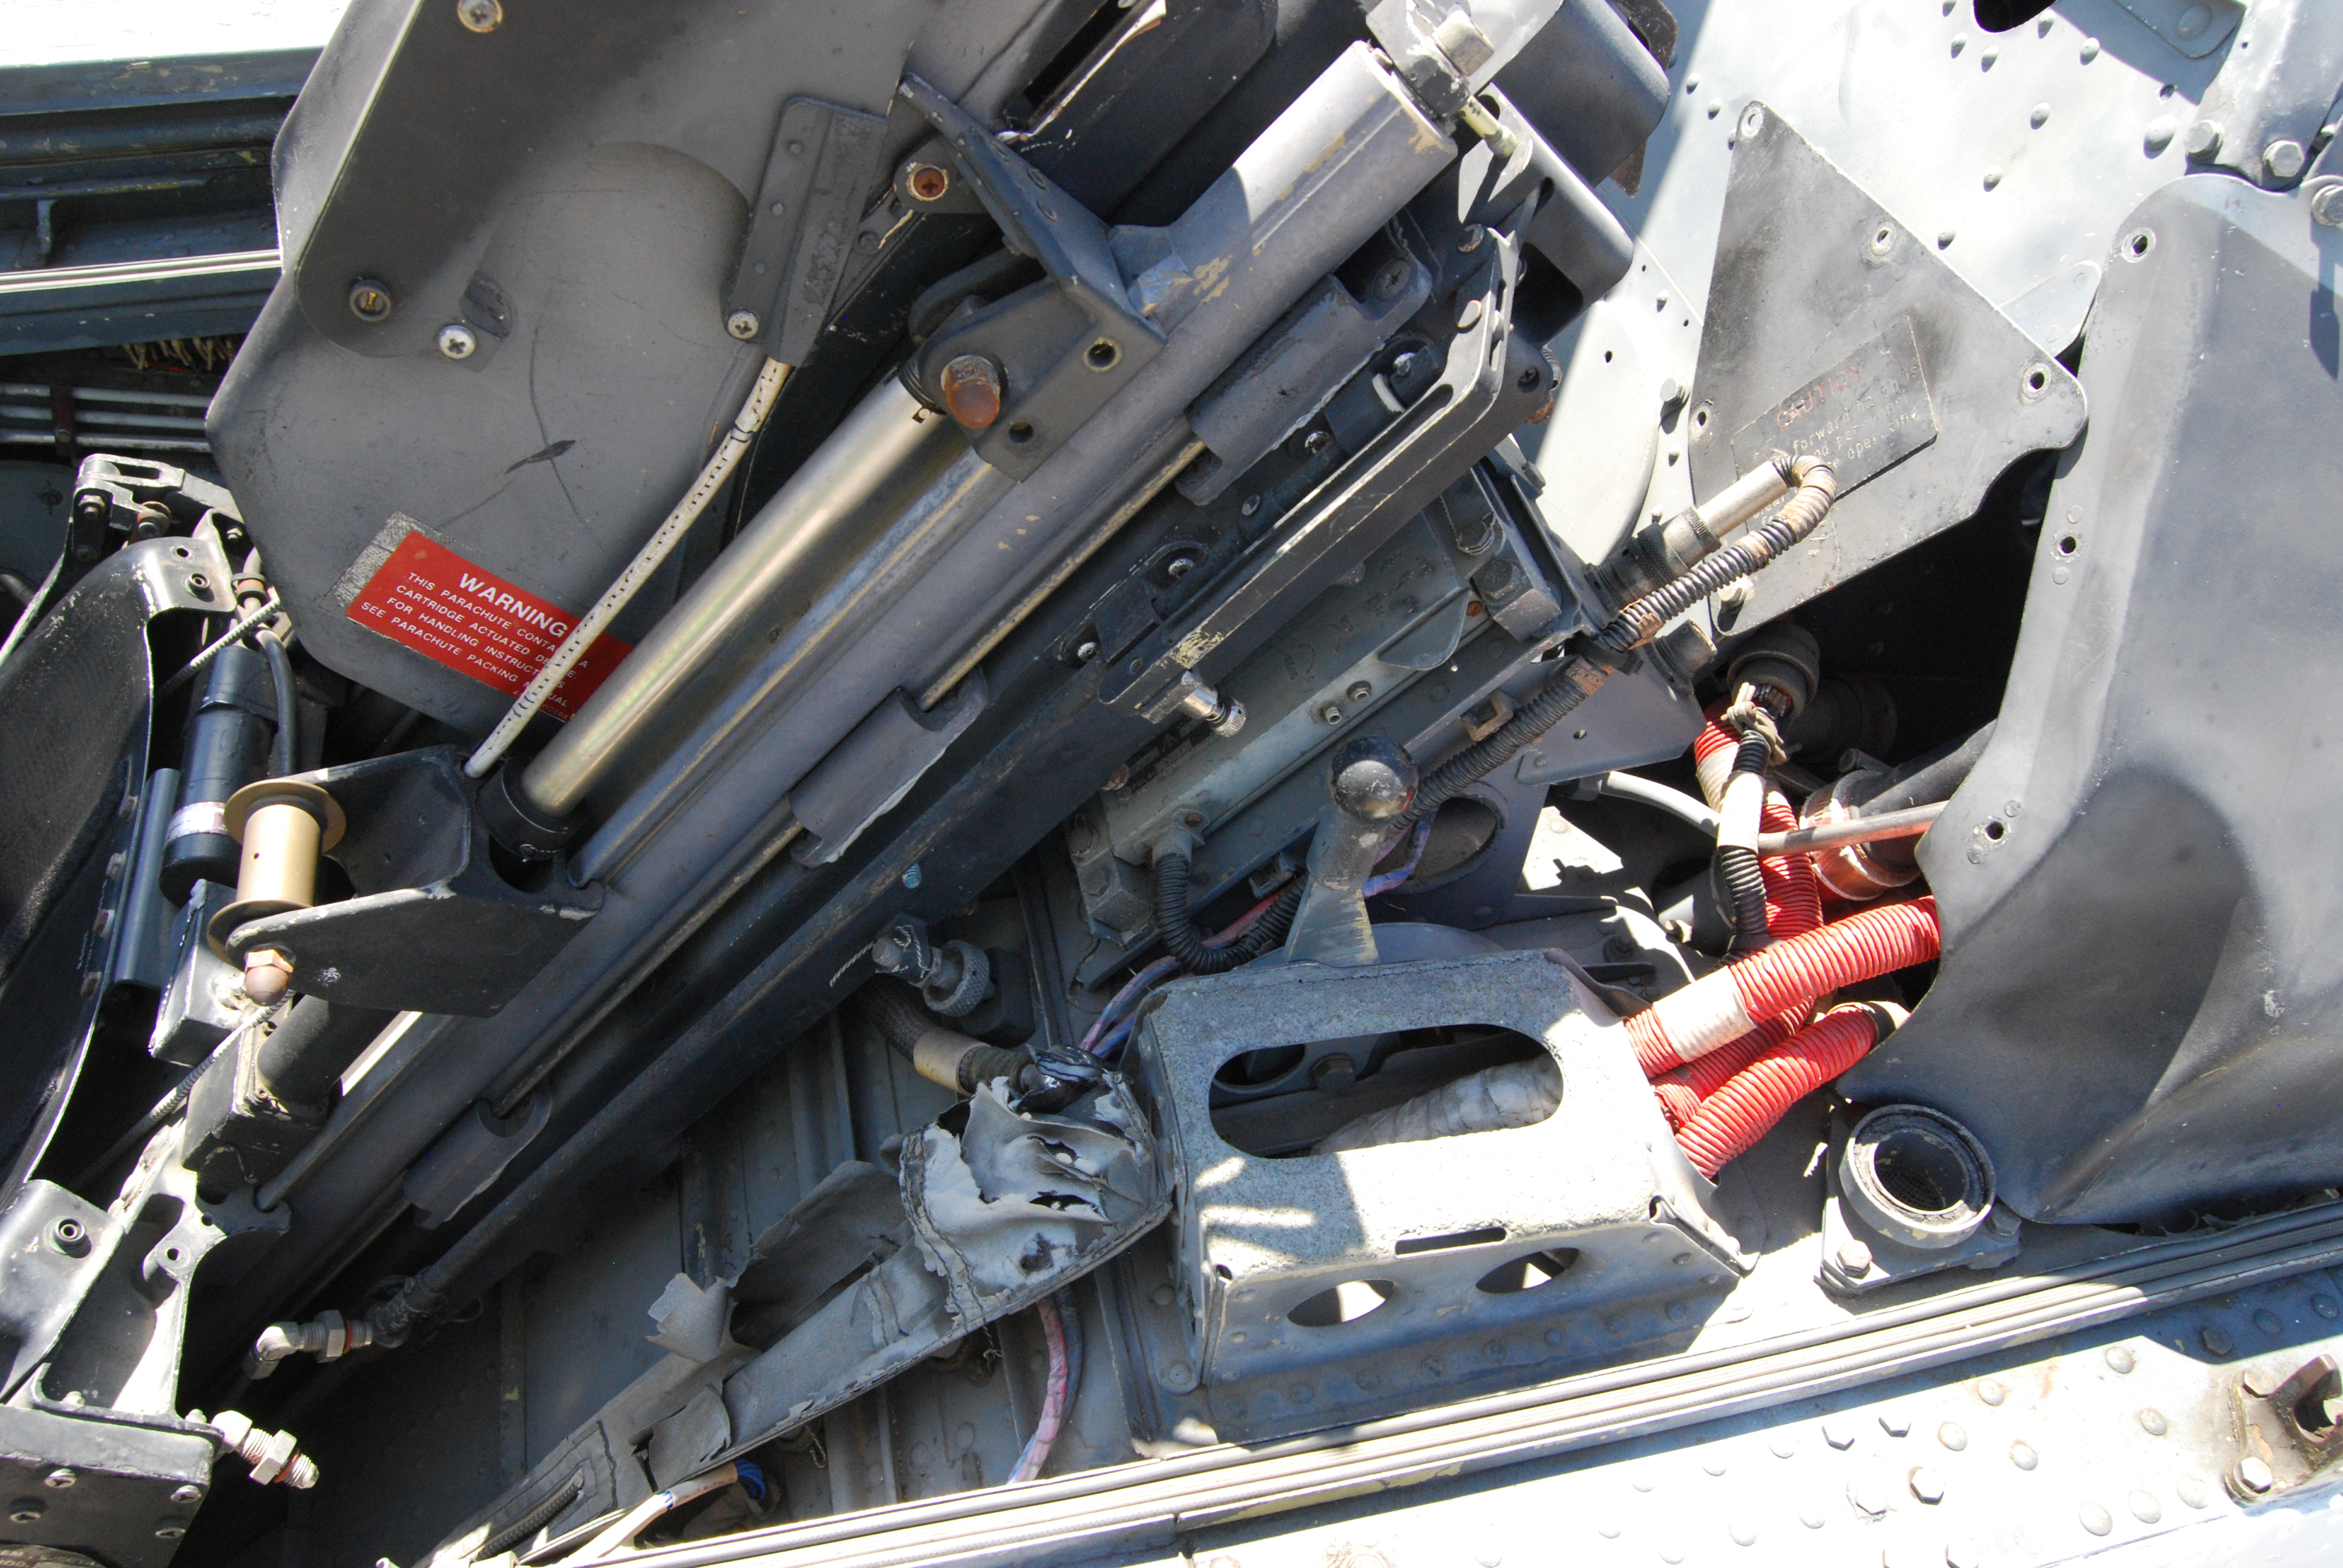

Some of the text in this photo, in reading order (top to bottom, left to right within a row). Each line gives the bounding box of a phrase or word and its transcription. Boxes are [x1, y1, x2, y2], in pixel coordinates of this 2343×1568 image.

[1777, 361, 1863, 429] CAUTION
[1792, 407, 1849, 454] forward
[387, 598, 413, 614] FOR
[419, 613, 478, 646] HANDLING
[397, 586, 464, 622] CARTRIDGE
[470, 623, 529, 654] ACTUATED
[408, 572, 435, 590] THIS
[441, 590, 511, 629] PARACHUTE
[517, 629, 554, 652] CONTA
[459, 573, 567, 637] WARNING
[362, 603, 385, 617] SEE
[391, 617, 461, 655] PARACHUTE
[467, 655, 517, 681] PACKING
